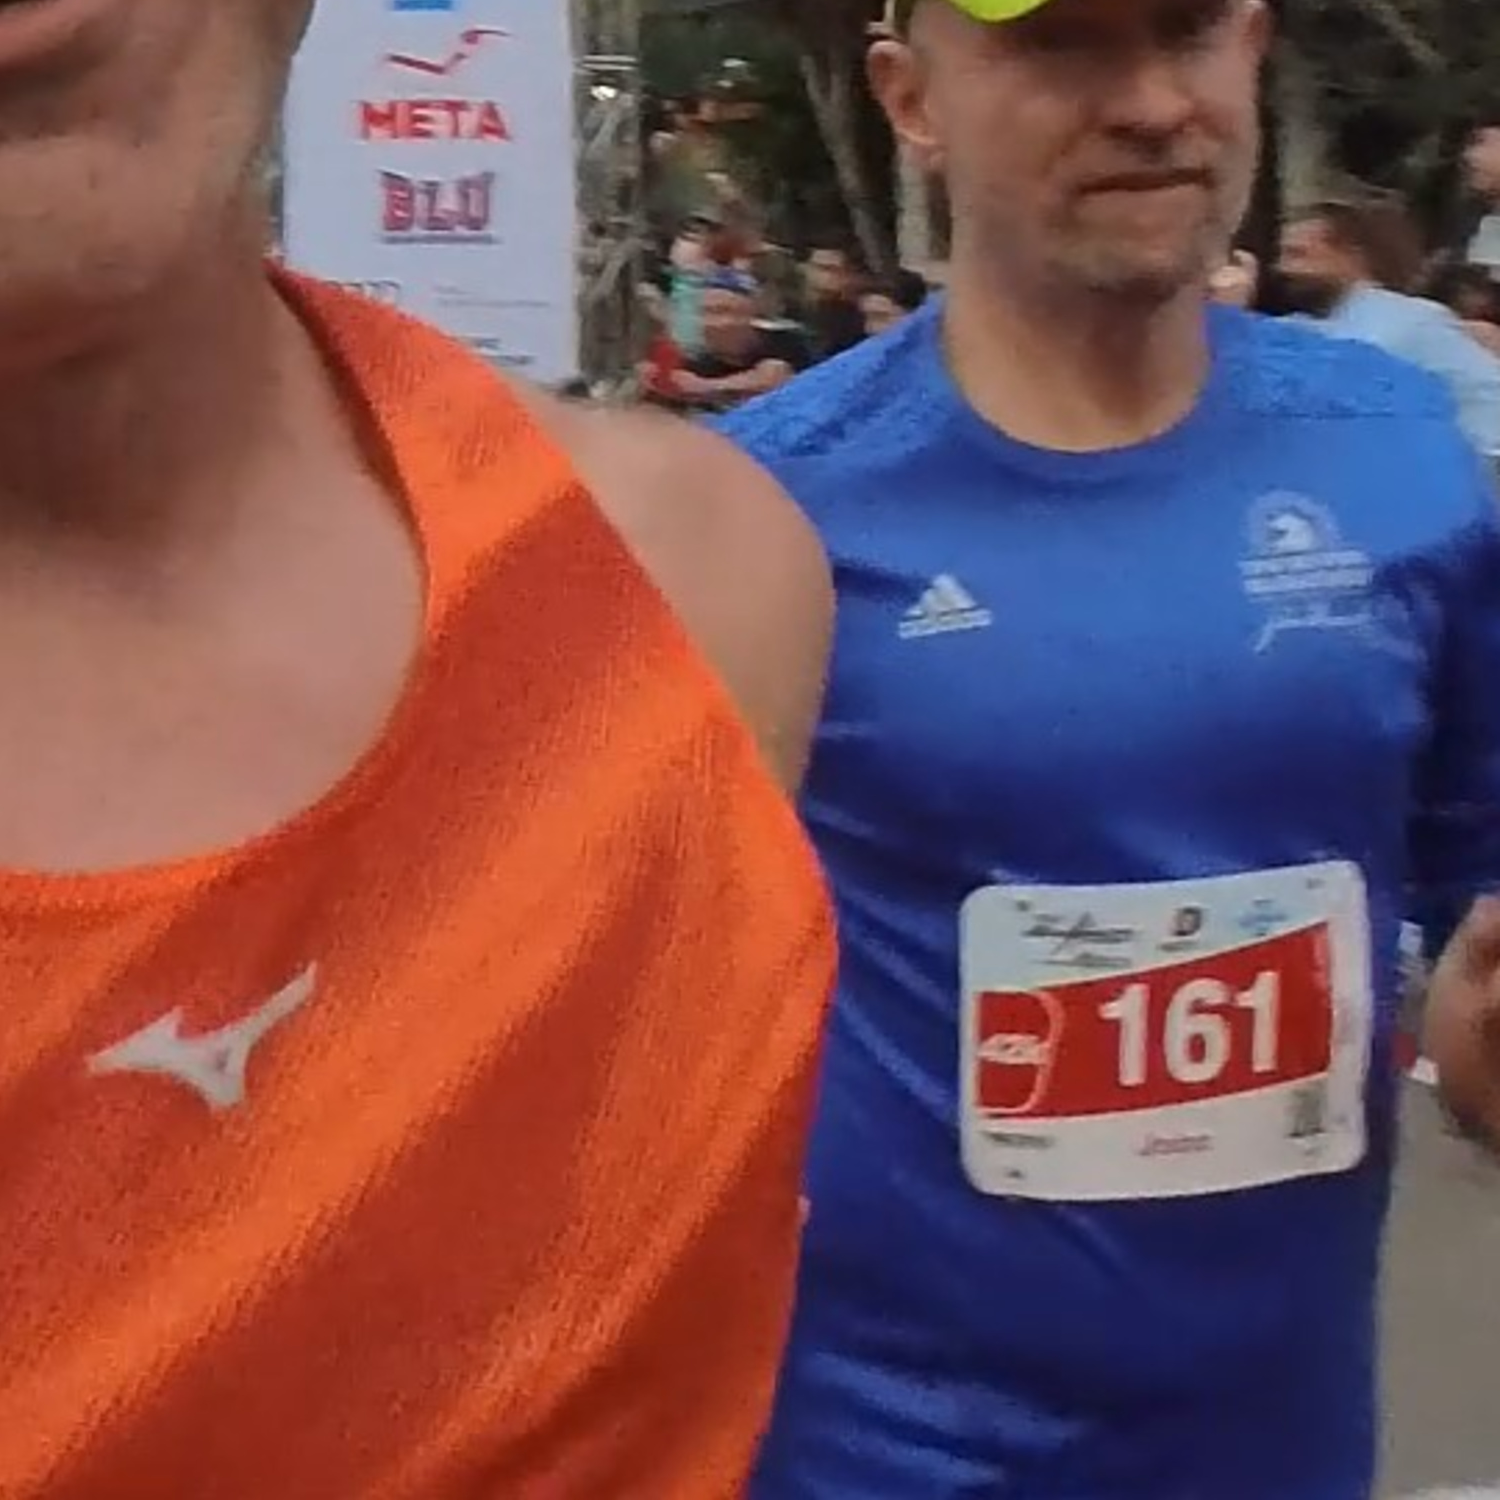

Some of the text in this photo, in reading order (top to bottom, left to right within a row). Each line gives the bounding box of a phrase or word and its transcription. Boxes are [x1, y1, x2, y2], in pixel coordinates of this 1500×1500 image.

[360, 99, 513, 140] META
[375, 169, 495, 234] BLU
[1099, 970, 1281, 1087] 161
